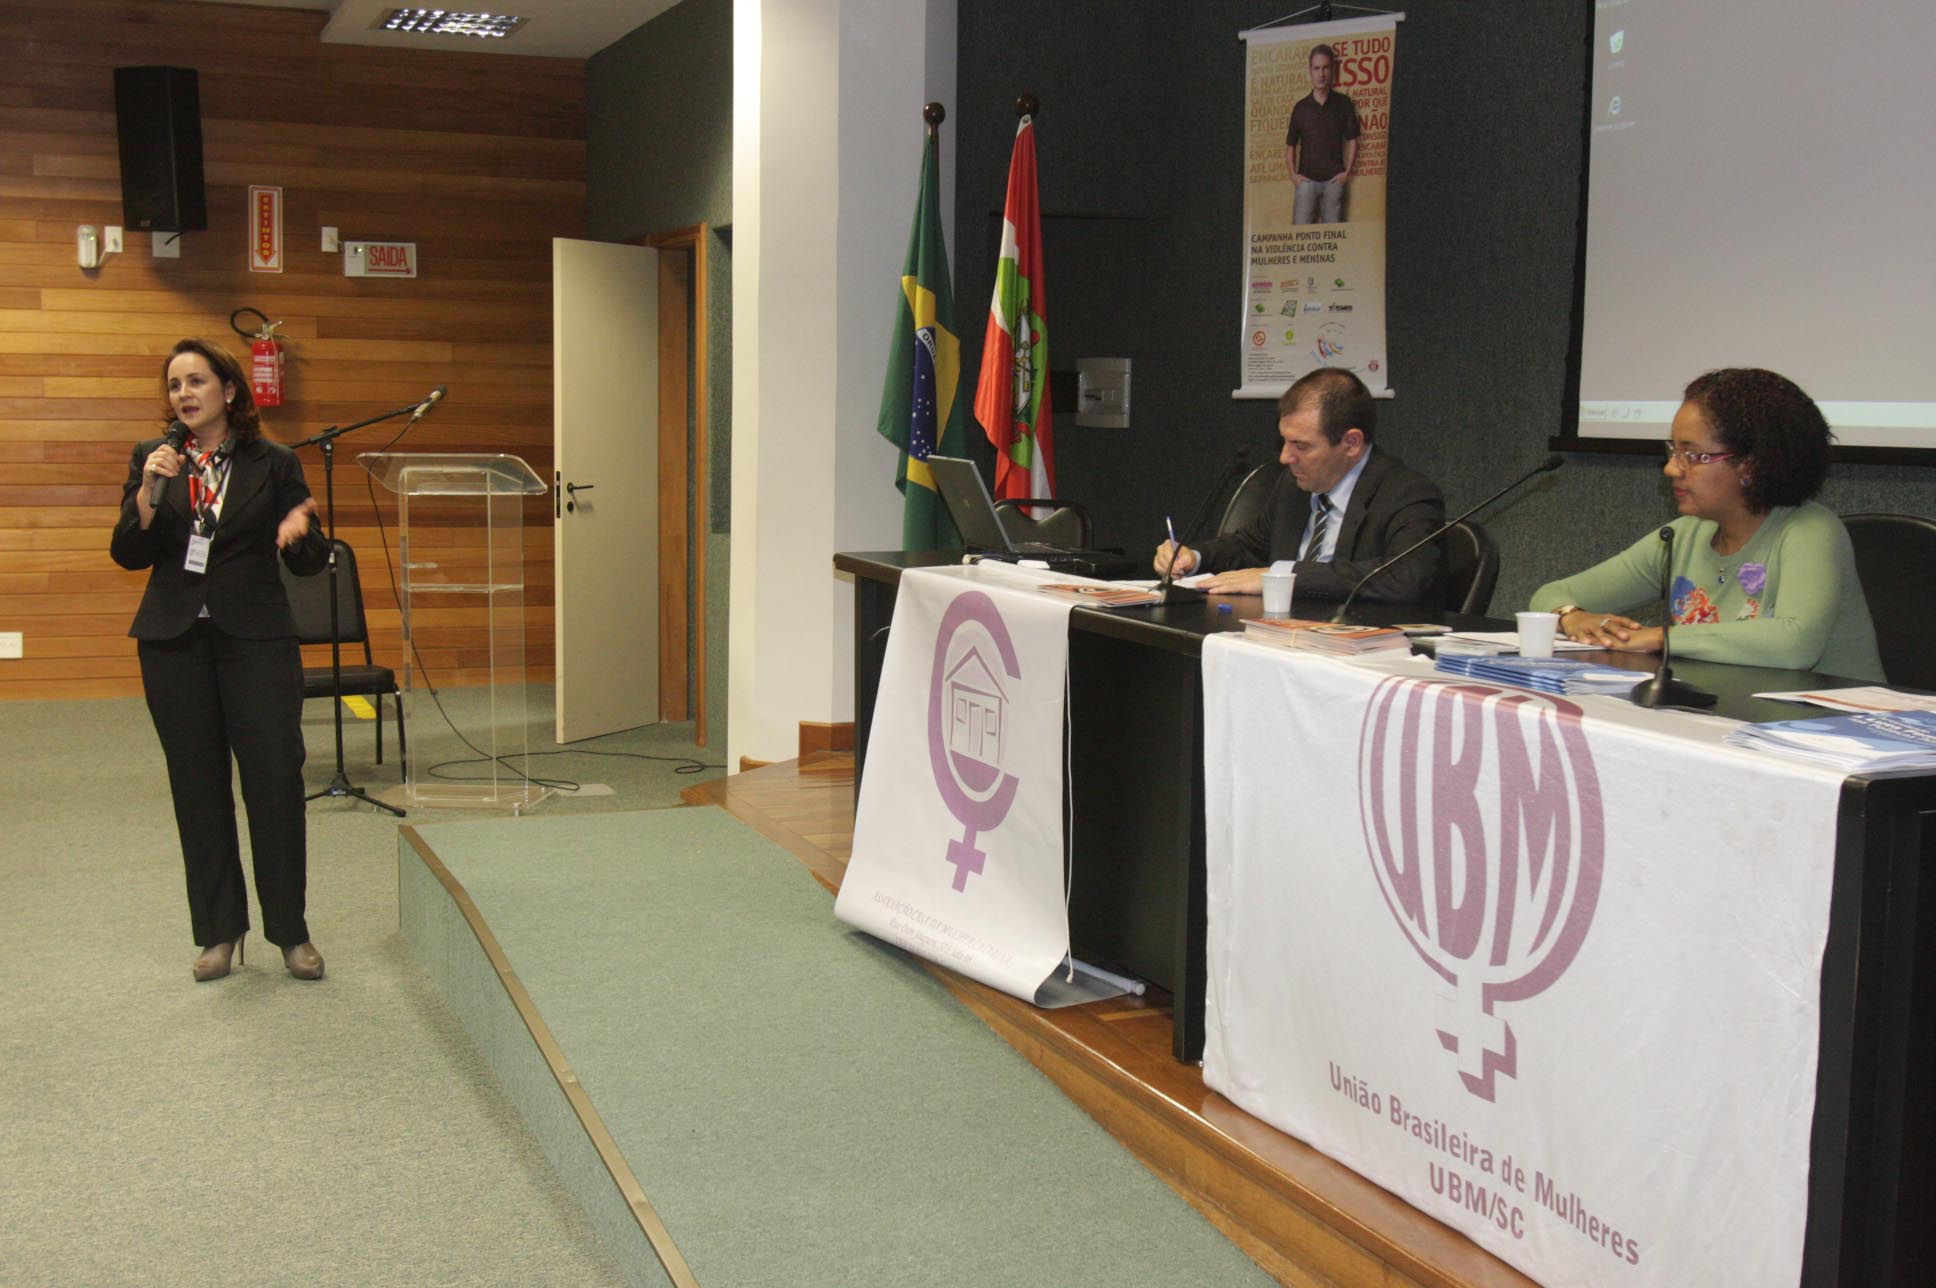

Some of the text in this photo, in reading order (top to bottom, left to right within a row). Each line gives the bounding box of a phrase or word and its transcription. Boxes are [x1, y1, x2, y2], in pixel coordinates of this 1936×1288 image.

[1332, 37, 1391, 57] SE TUDO
[1334, 55, 1390, 88] ISSO
[1352, 88, 1388, 97] NATURAL
[1359, 108, 1388, 130] NÃO
[1251, 230, 1347, 243] CAMPANHA PONTO FINAL
[1251, 242, 1338, 254] NA VIOLÊNCIA CONTRA
[1251, 253, 1336, 266] MULHERES E MENINAS
[1370, 677, 1572, 966] UBM
[1329, 1061, 1639, 1265] União Brasileira de Mulheres
[1429, 1162, 1524, 1240] UBM/SC
